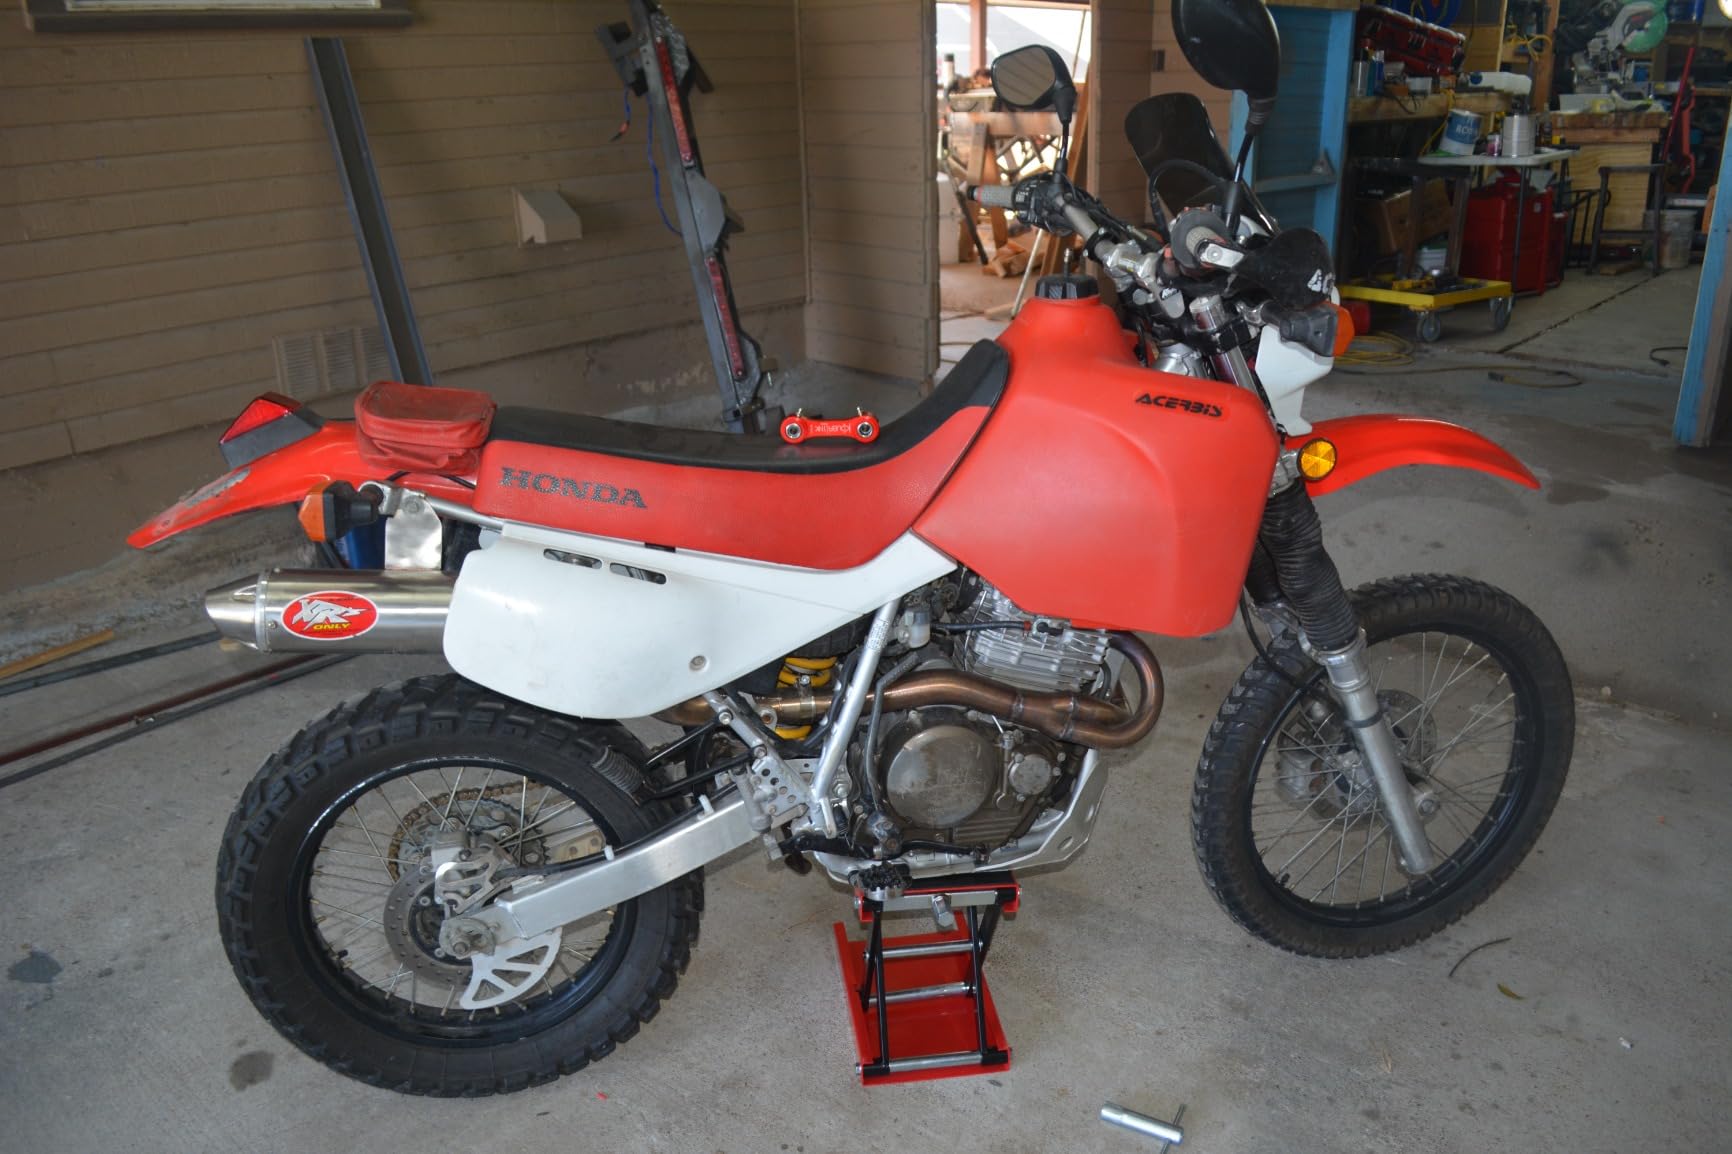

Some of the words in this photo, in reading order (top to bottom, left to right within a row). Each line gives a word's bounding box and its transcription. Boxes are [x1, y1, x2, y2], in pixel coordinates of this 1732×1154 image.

[1136, 393, 1222, 417] ACERBIS
[500, 466, 648, 509] HONDA
[313, 622, 352, 631] ONLY
